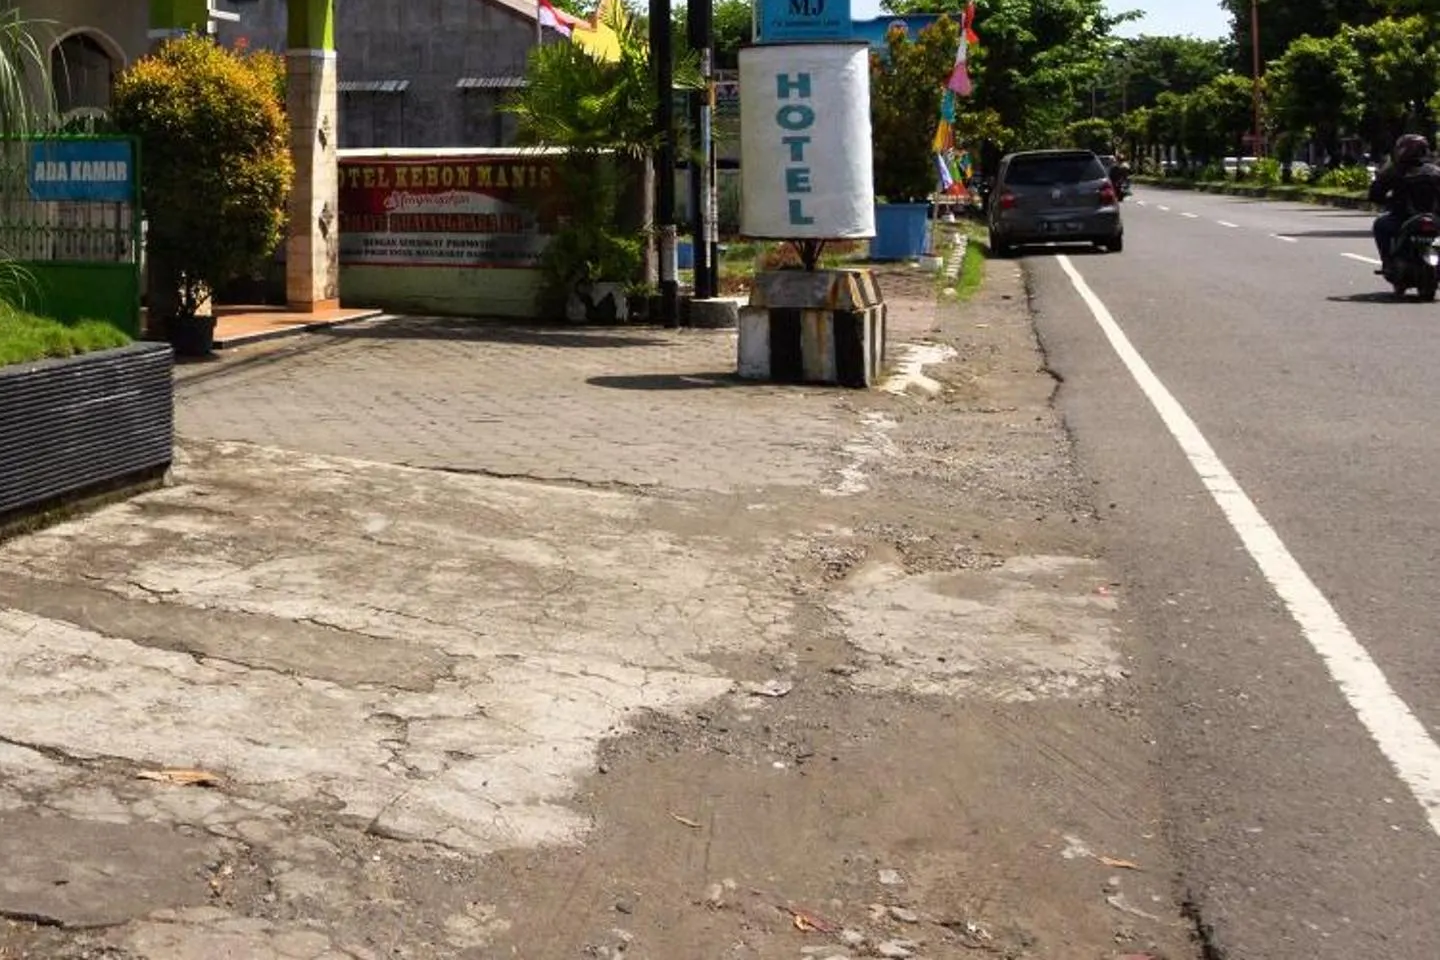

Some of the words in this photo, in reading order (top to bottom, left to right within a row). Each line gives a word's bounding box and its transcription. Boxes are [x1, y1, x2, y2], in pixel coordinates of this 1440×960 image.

[776, 73, 815, 225] HOTEL
[34, 160, 67, 182] ADA
[70, 160, 128, 182] KAMAR
[338, 166, 390, 188] OTEL
[395, 166, 470, 188] KEBON
[477, 164, 552, 188] MANIS
